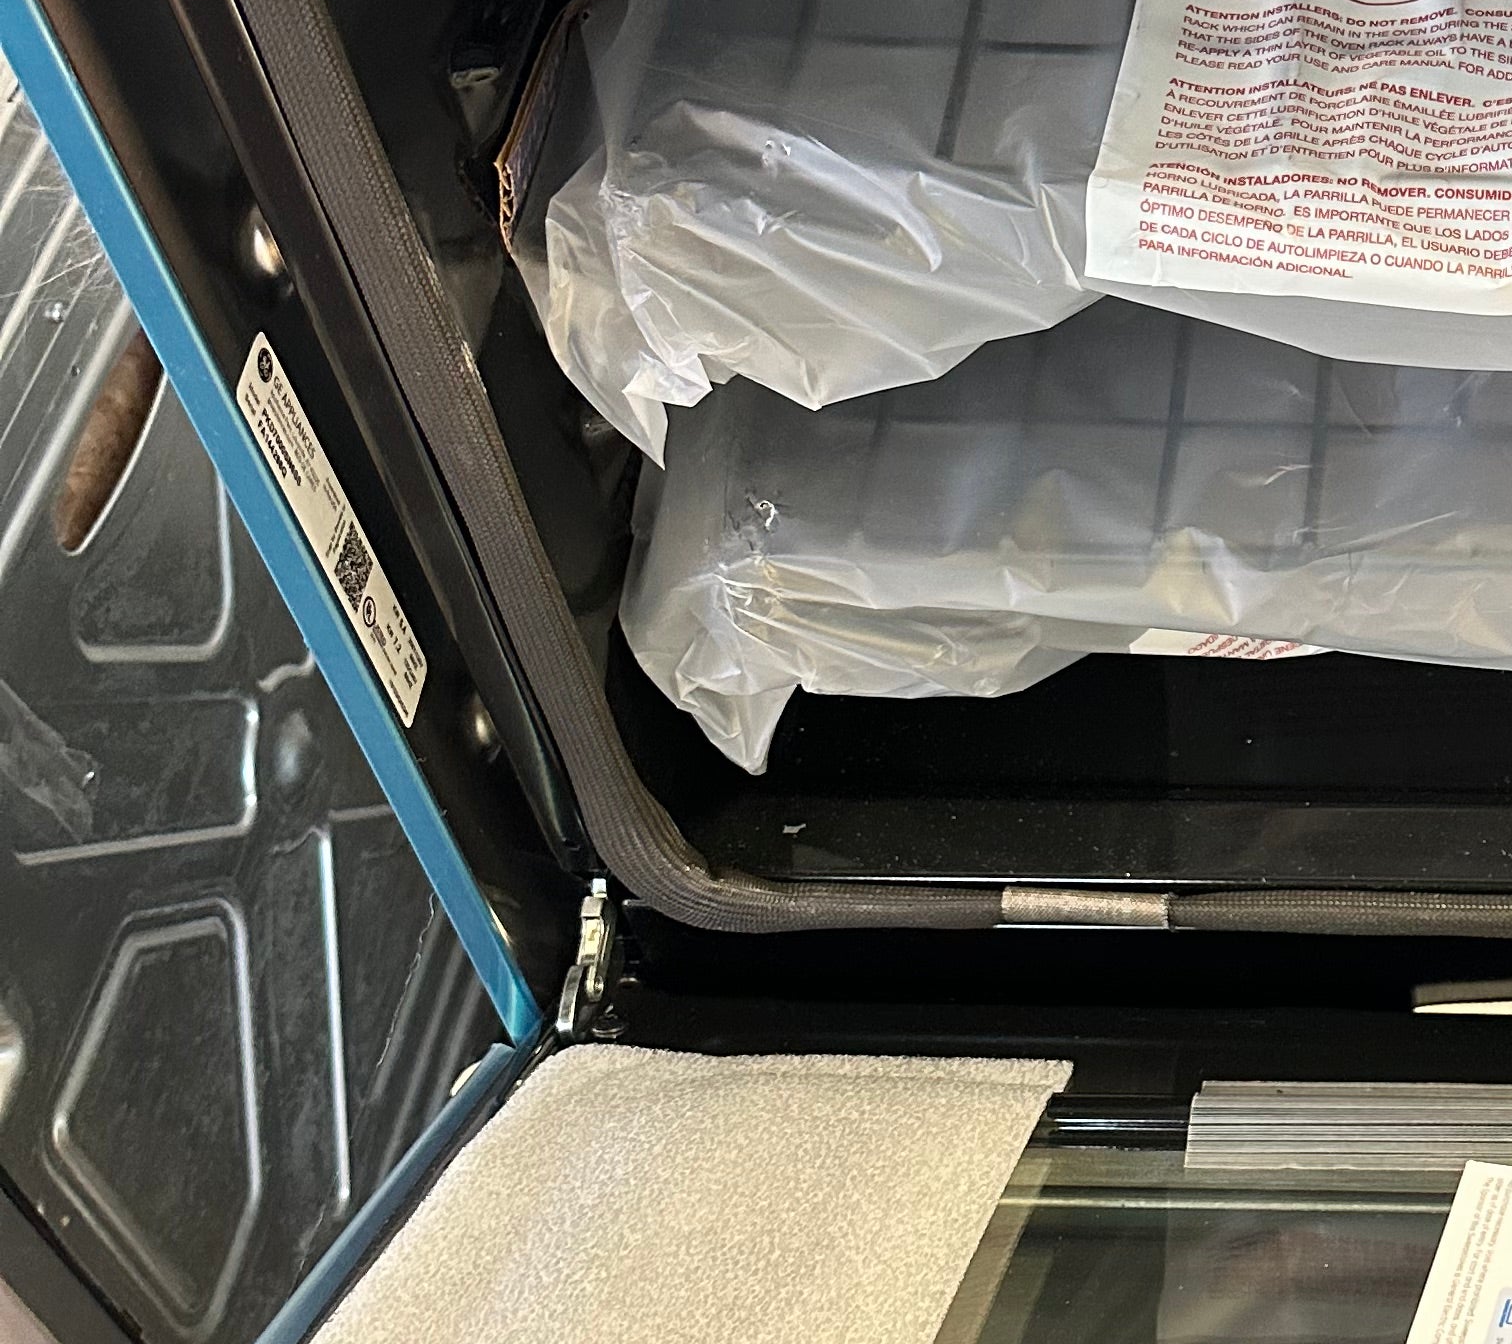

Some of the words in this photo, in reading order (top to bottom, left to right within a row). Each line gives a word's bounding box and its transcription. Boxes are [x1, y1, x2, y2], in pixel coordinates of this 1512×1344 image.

[1185, 4, 1259, 20] ATTENTION
[1262, 2, 1342, 22] INSTALLERS:
[1345, 17, 1366, 27] DO
[1368, 19, 1397, 27] NOT
[1399, 7, 1457, 25] REMOVE.
[1169, 77, 1245, 95] ATTENTION
[1248, 78, 1355, 97] INSTALLATEURS:
[1358, 80, 1377, 91] NE
[1380, 82, 1406, 96] PAS
[1409, 87, 1474, 107] ENLEVER.
[1148, 162, 1220, 180] ATENCIÓN
[1223, 173, 1333, 186] INSTALADORES:
[1336, 177, 1358, 186] NO
[1361, 177, 1430, 198] REMOVER.
[1138, 238, 1174, 254] PARA
[1177, 245, 1272, 268] INFORMACIÓN
[1275, 261, 1352, 278] ADICIONAL.
[282, 393, 316, 460] APPLIANCES
